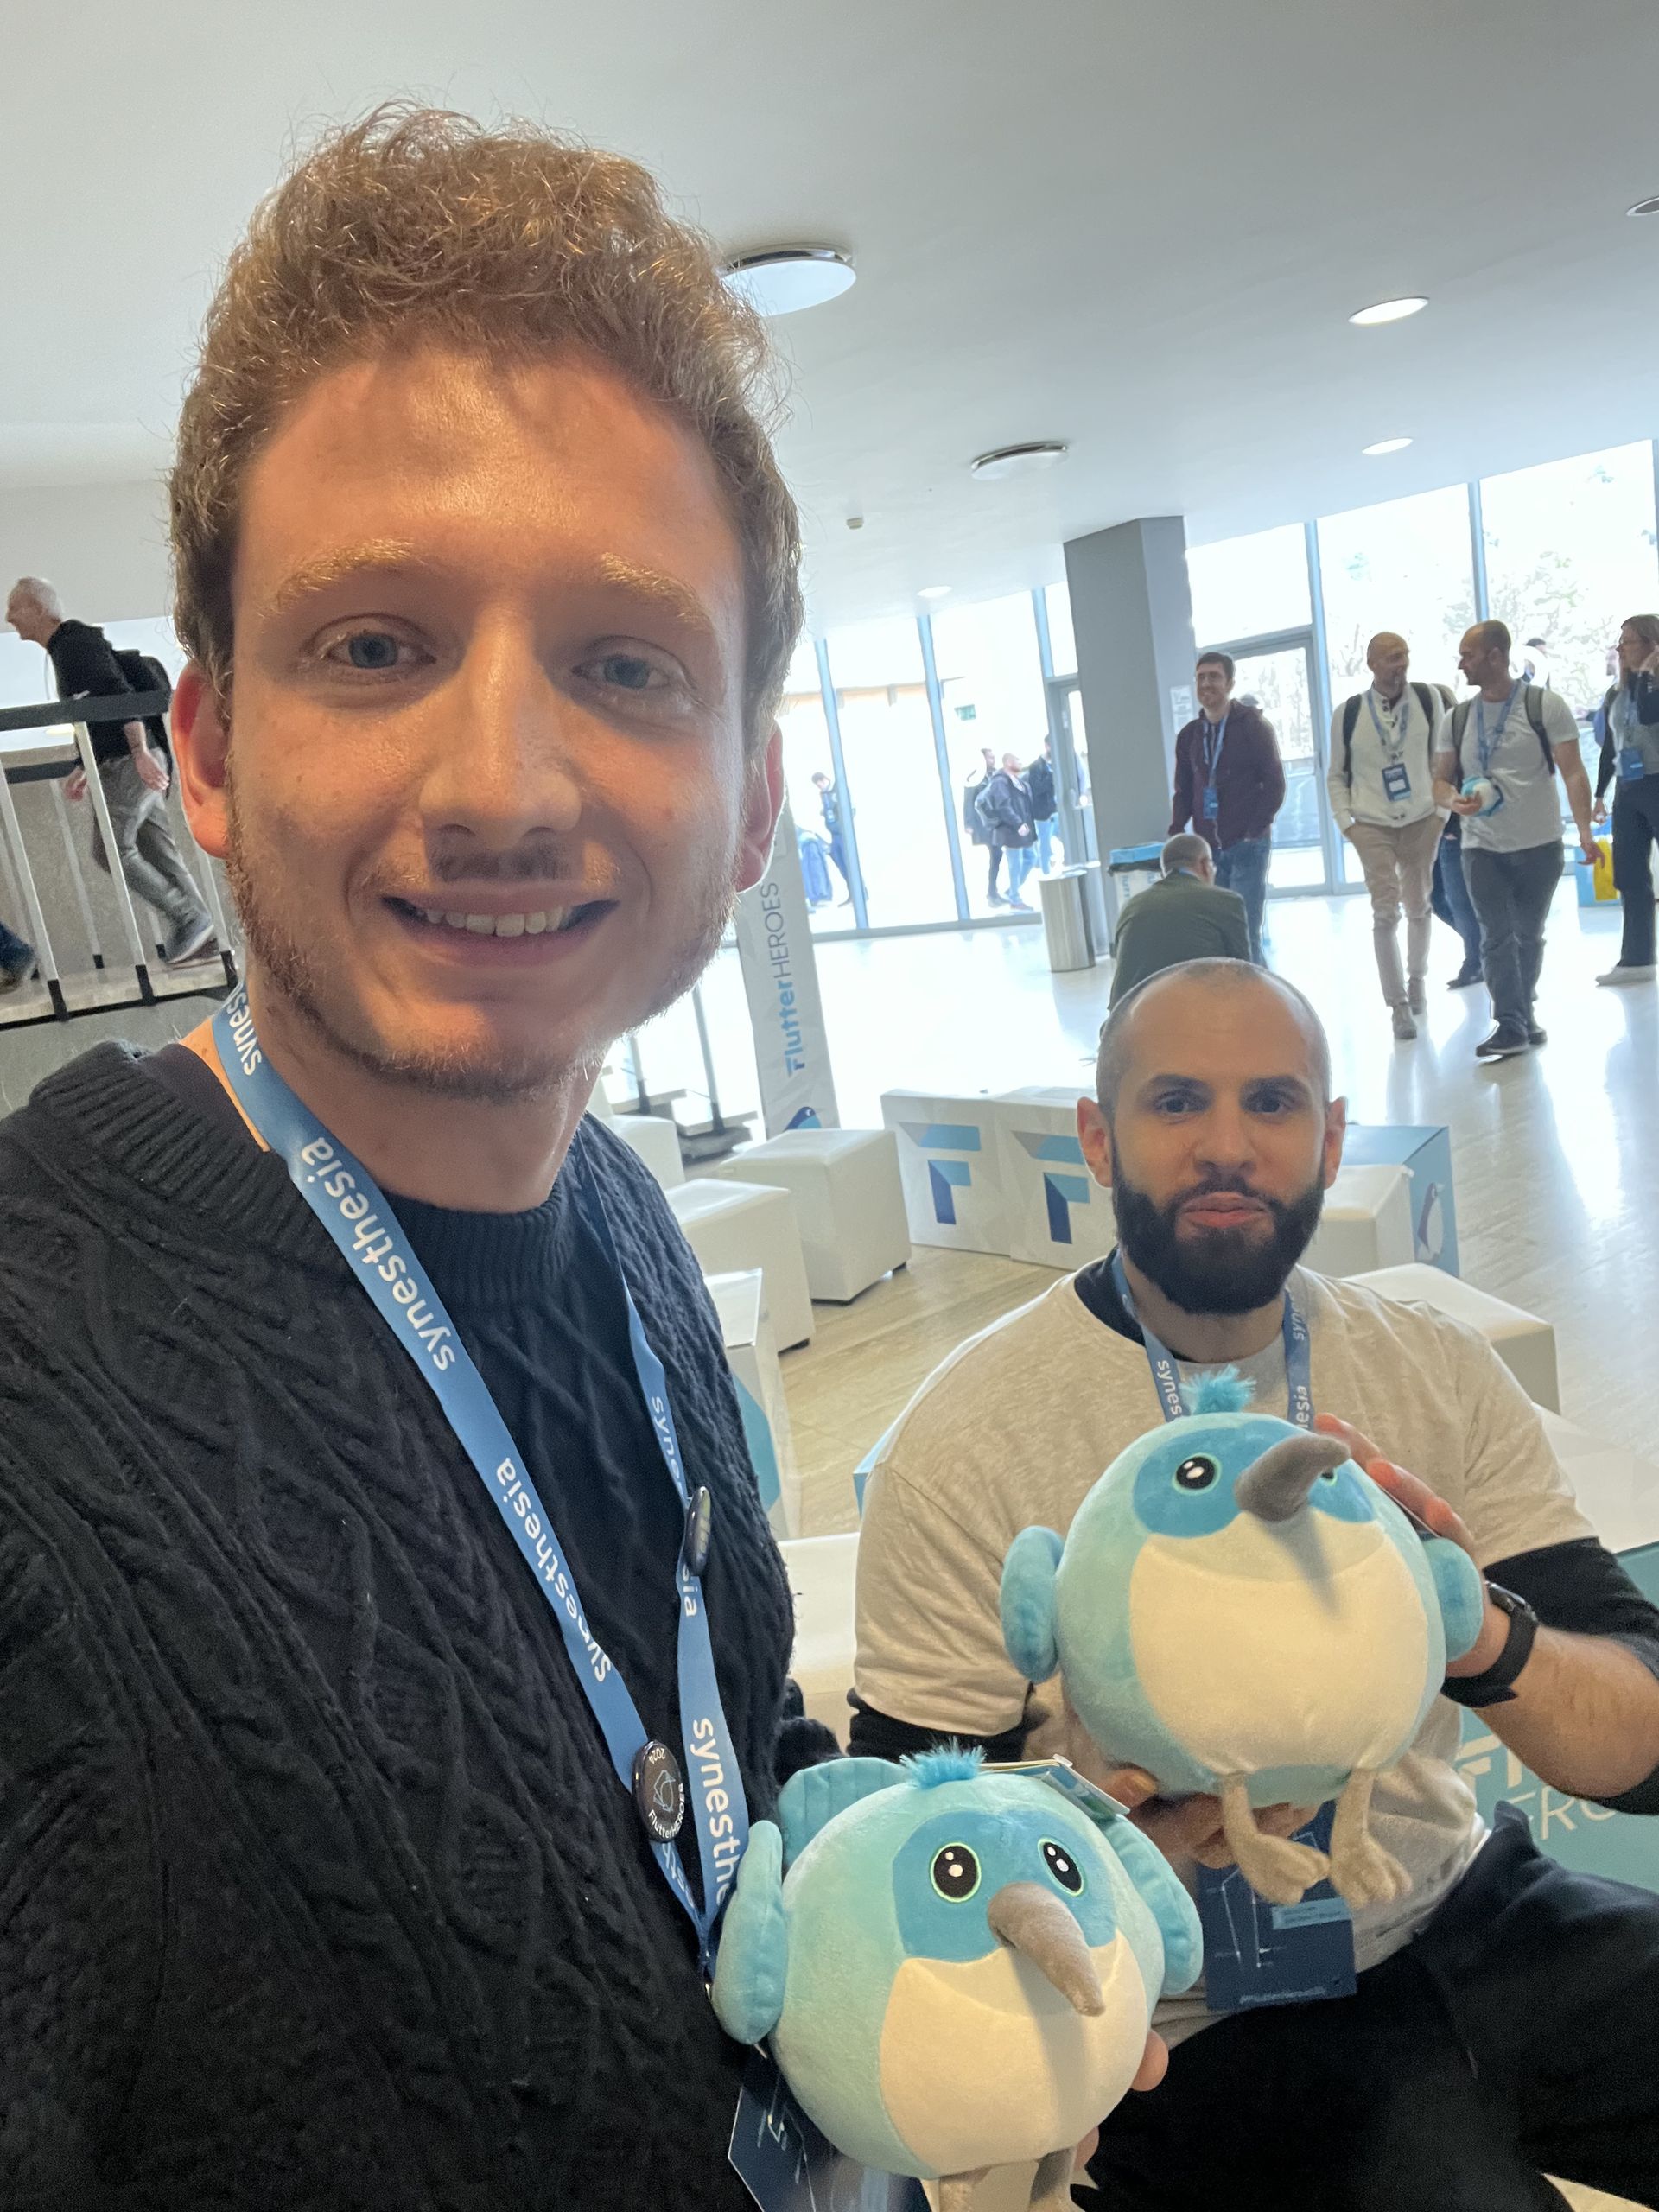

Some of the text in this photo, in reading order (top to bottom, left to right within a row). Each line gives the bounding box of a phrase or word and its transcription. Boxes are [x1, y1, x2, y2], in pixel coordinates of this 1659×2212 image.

[760, 882, 805, 1077] FlutterHEROES
[301, 1137, 455, 1371] synesthesia
[648, 1747, 666, 1764] 2024
